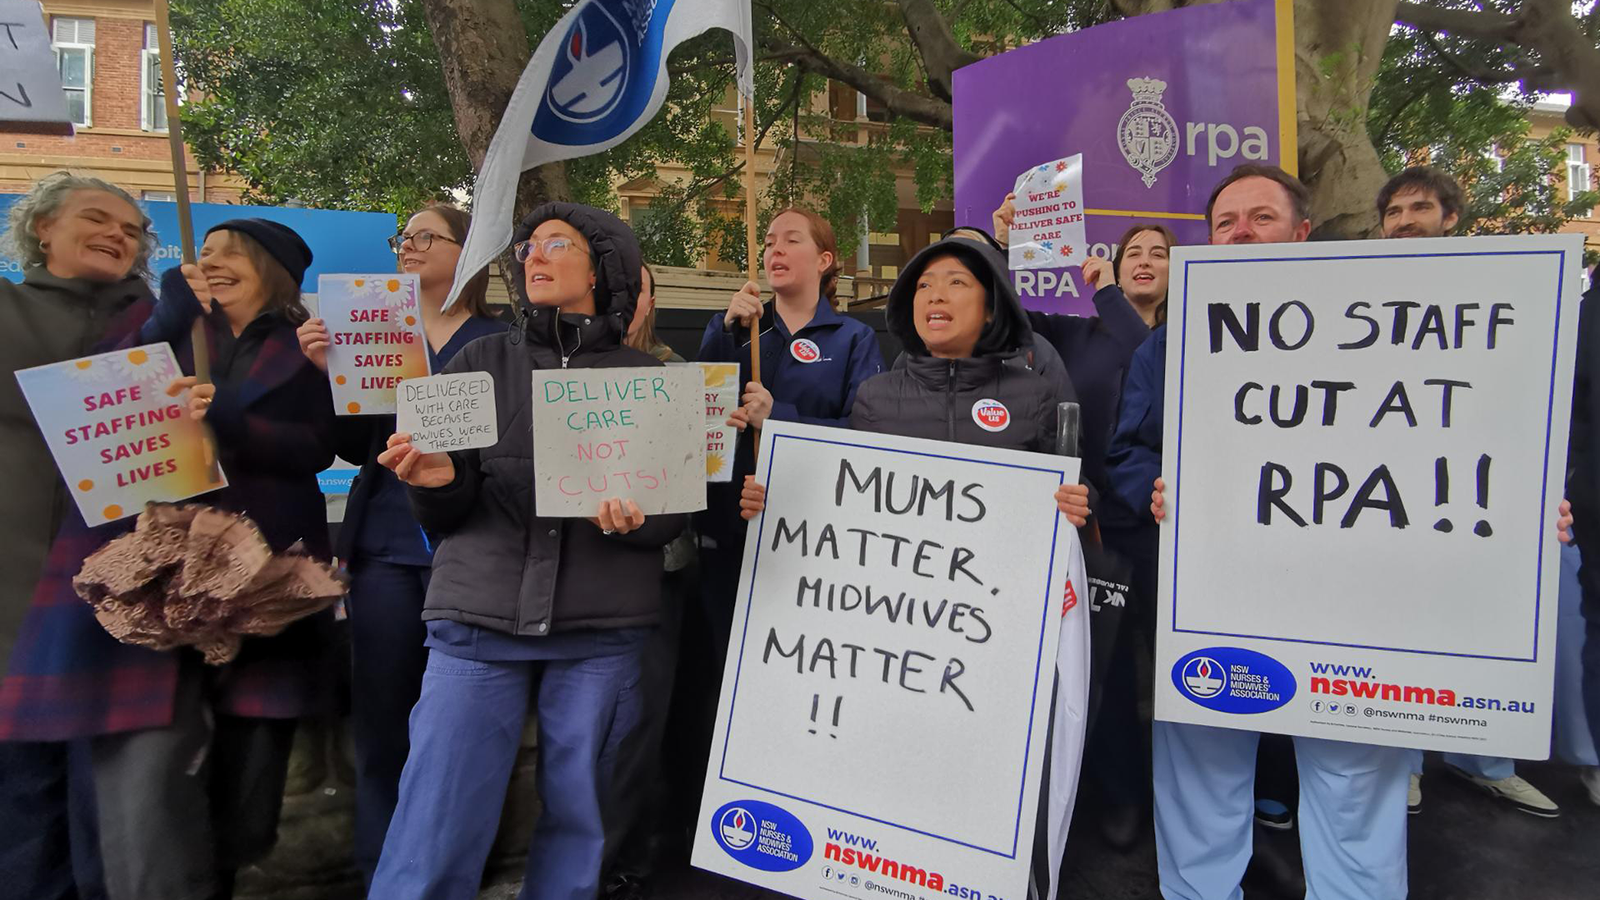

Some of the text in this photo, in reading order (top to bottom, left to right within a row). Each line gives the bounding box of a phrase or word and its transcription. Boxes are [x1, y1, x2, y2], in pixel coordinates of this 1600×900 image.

[1186, 121, 1269, 167] rpa
[1028, 190, 1061, 203] WE'RE
[1016, 200, 1076, 218] PUSHING TO
[1011, 213, 1083, 231] DELIVER SAFE
[1033, 231, 1061, 241] CARE
[1015, 270, 1080, 298] RPA
[350, 309, 389, 323] SAFE
[1207, 300, 1515, 354] NO STAFF
[334, 331, 414, 345] STAFFING
[354, 353, 403, 368] SAVES
[83, 384, 142, 412] SAFE
[405, 379, 490, 402] DELIVERED
[544, 377, 671, 404] DELIVER
[705, 393, 719, 403] RY
[415, 398, 479, 415] WITH CARE
[706, 406, 725, 416] ITY
[980, 407, 1004, 417] Value
[1234, 378, 1472, 428] CUT AT
[64, 402, 182, 445] STAFFING
[421, 411, 472, 428] BECAUSE
[566, 409, 635, 431] CARE
[409, 424, 491, 442] IDWIVES WERE
[706, 431, 724, 440] ND
[100, 432, 171, 465] SAVES
[428, 436, 470, 449] THERE!
[577, 439, 630, 461] NOT
[707, 442, 724, 451] ET!
[116, 458, 177, 488] LIVES
[558, 468, 667, 496] CUTS!
[835, 458, 987, 523] MUMS
[1257, 453, 1493, 538] RPA!!
[771, 517, 1000, 596] MATTER.
[796, 576, 992, 644] MIDWIVES
[762, 627, 975, 712] MATTER
[1230, 664, 1250, 674] NSW
[1309, 662, 1376, 679] www.
[1230, 673, 1269, 684] NURSES &
[1229, 689, 1280, 701] ASSOCIATION
[1310, 676, 1535, 714] nswnma.asn.au
[1363, 707, 1487, 727] @nswnma #nswnma
[760, 820, 778, 831] NSW
[760, 828, 792, 844] NURSES &
[827, 827, 880, 853] www.
[757, 844, 798, 863] ASSOCIATION
